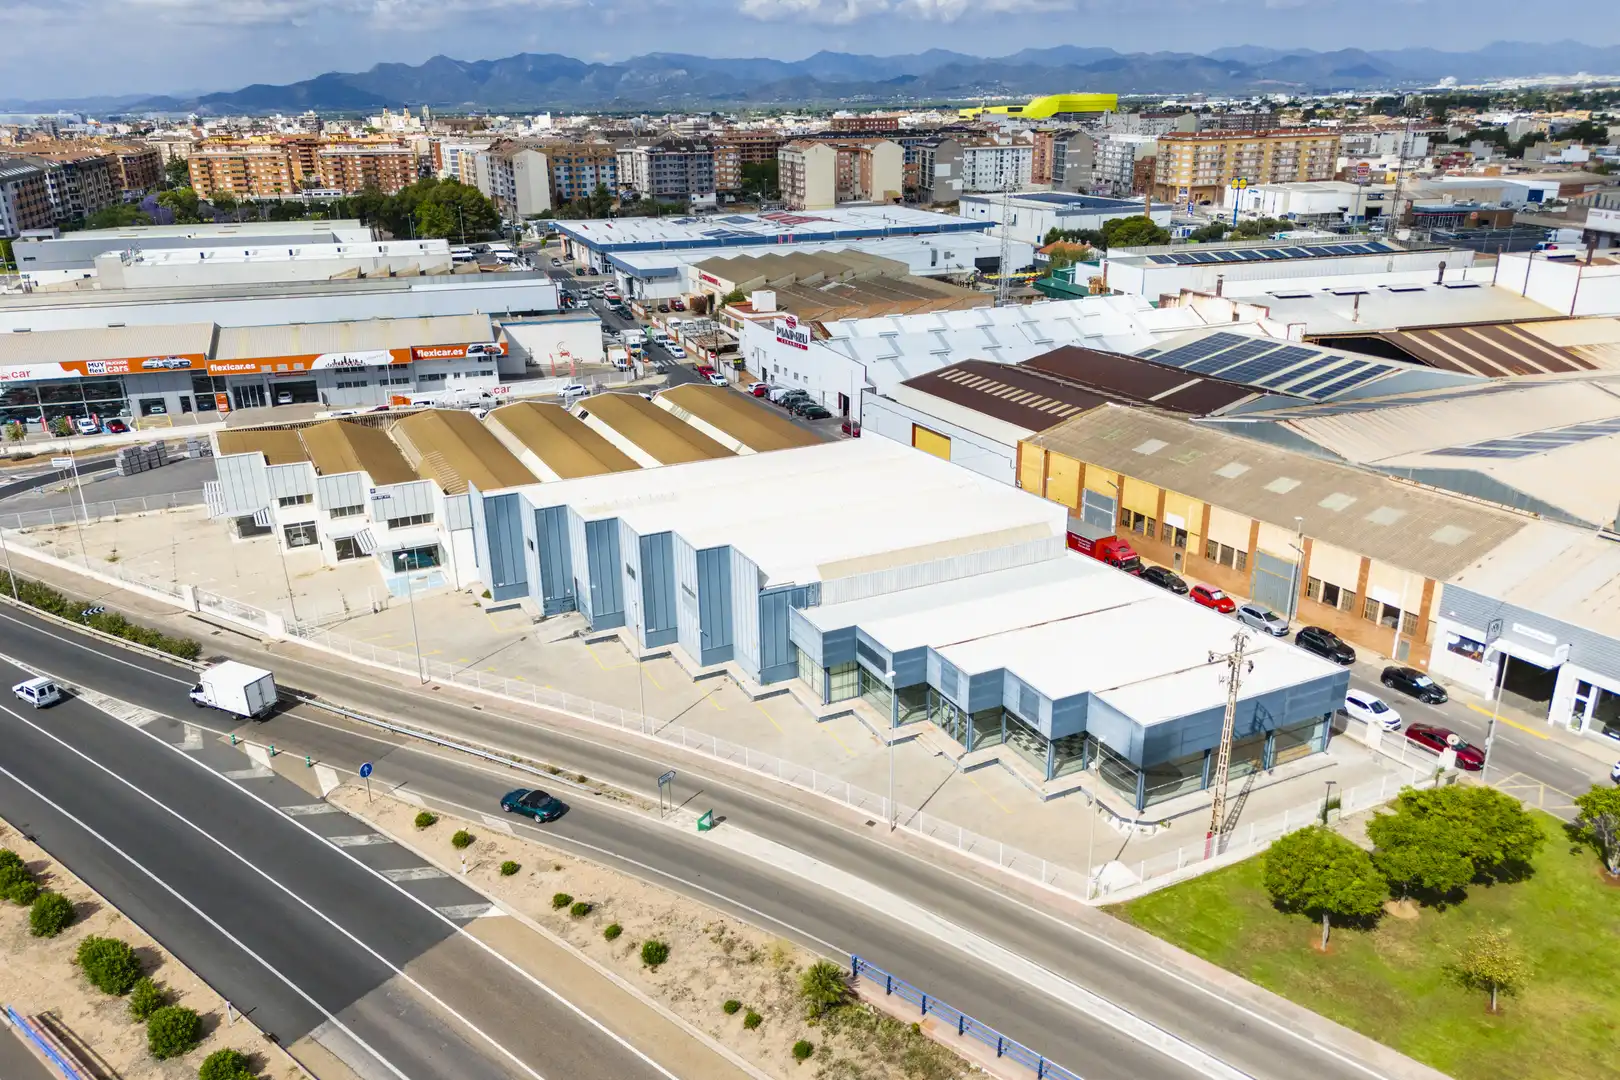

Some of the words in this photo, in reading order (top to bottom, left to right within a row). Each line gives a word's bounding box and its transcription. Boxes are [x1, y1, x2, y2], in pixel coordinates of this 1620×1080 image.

[416, 348, 464, 357] flexicar.es
[107, 365, 129, 373] cars
[209, 363, 256, 372] flexicar.es
[11, 370, 31, 379] car
